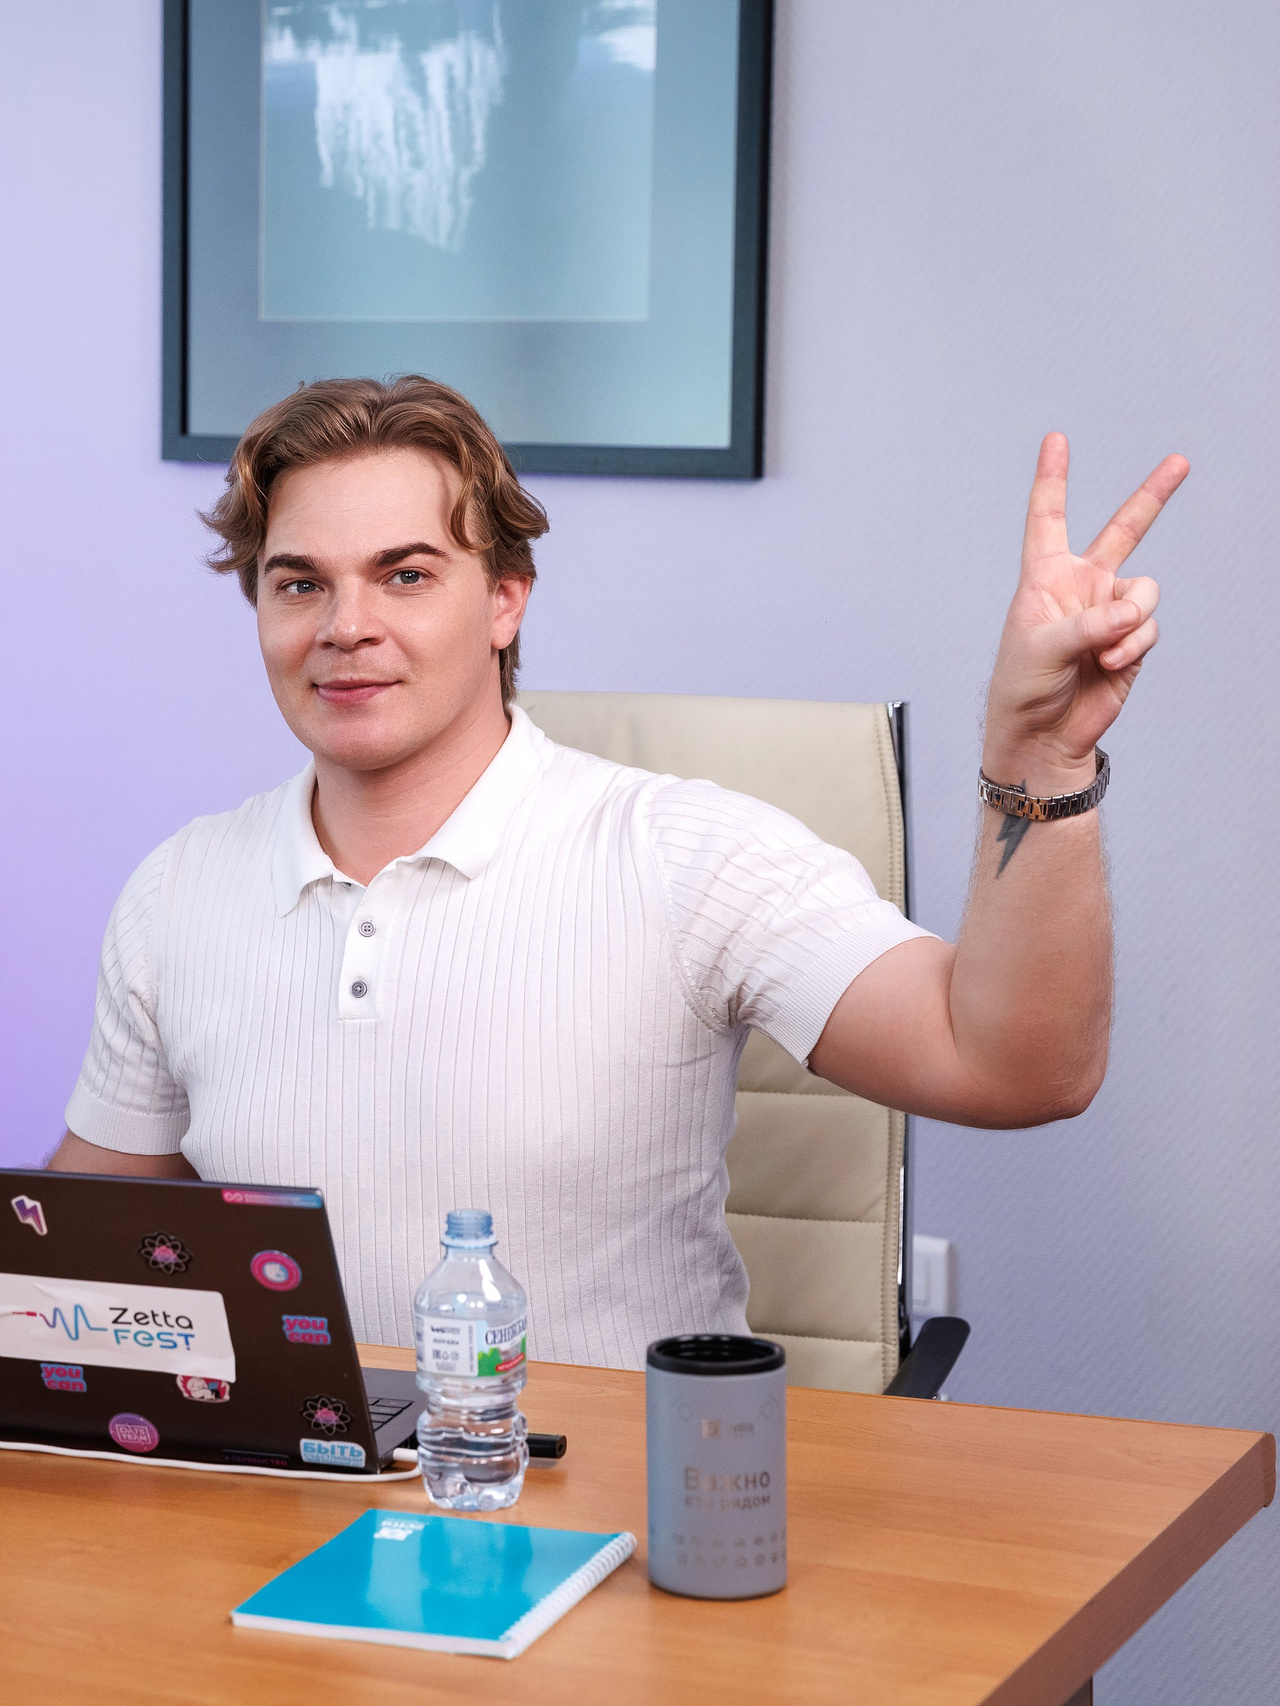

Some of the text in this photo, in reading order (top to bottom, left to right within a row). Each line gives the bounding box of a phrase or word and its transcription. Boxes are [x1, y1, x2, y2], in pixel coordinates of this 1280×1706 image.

[109, 1306, 194, 1330] Zetta
[285, 1317, 326, 1332] you
[287, 1332, 328, 1345] can
[43, 1364, 81, 1379] you
[46, 1379, 84, 1391] can
[303, 1441, 363, 1457] БЫТЬ
